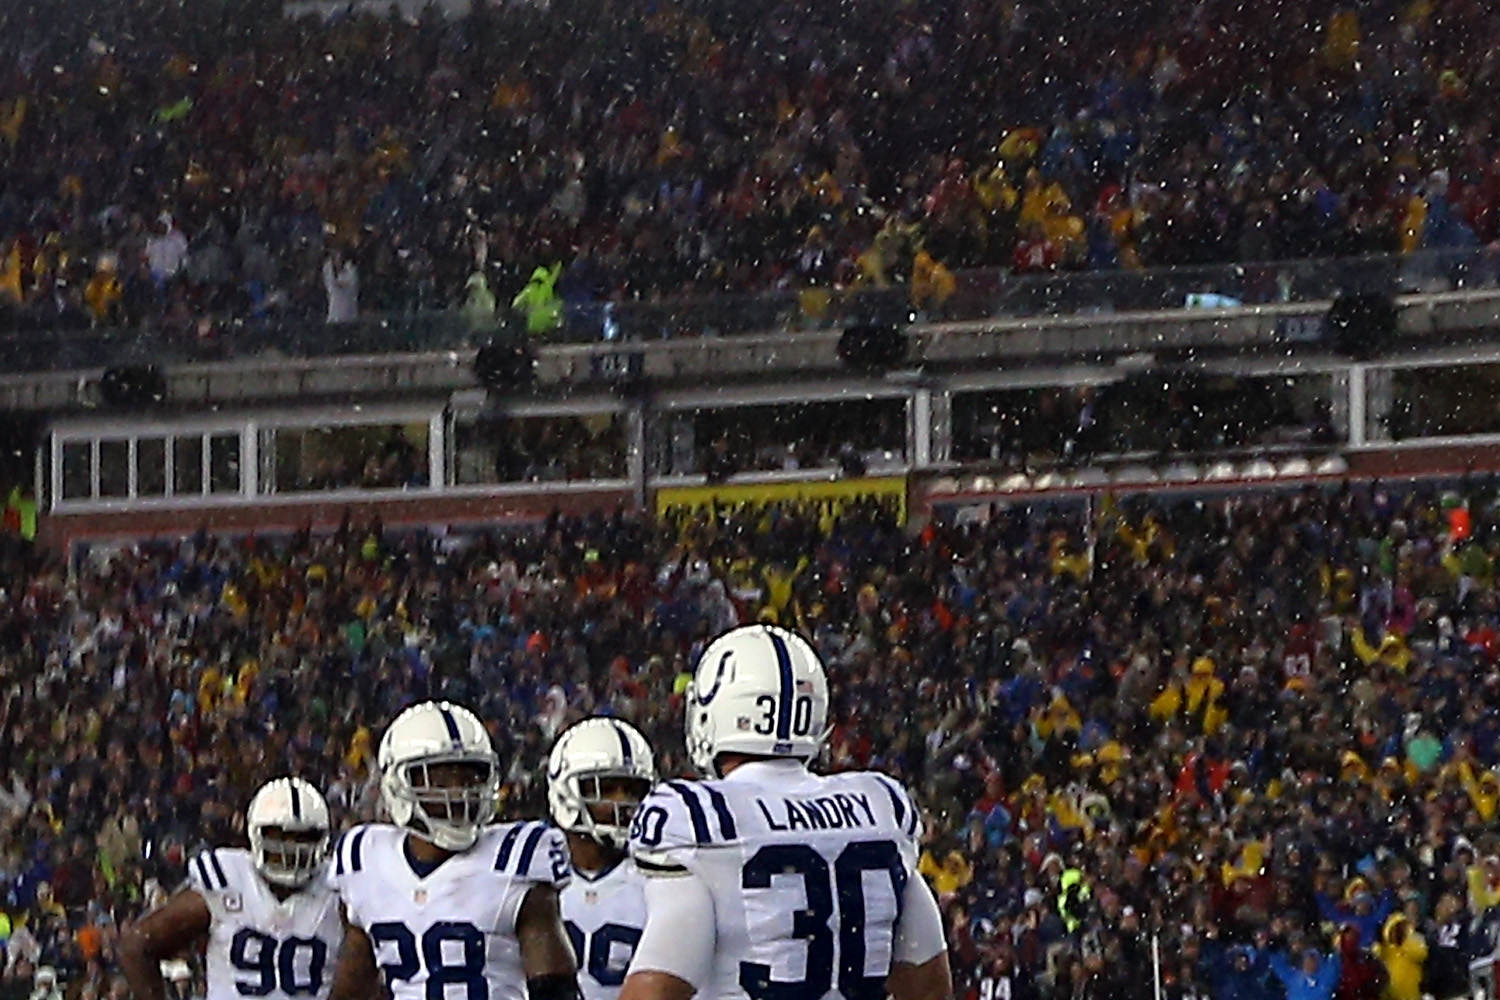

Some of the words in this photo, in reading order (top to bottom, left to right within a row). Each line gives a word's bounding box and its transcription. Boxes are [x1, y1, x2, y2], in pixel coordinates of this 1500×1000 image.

[754, 694, 813, 737] 30
[756, 793, 877, 832] LANDRY
[229, 926, 328, 997] 90
